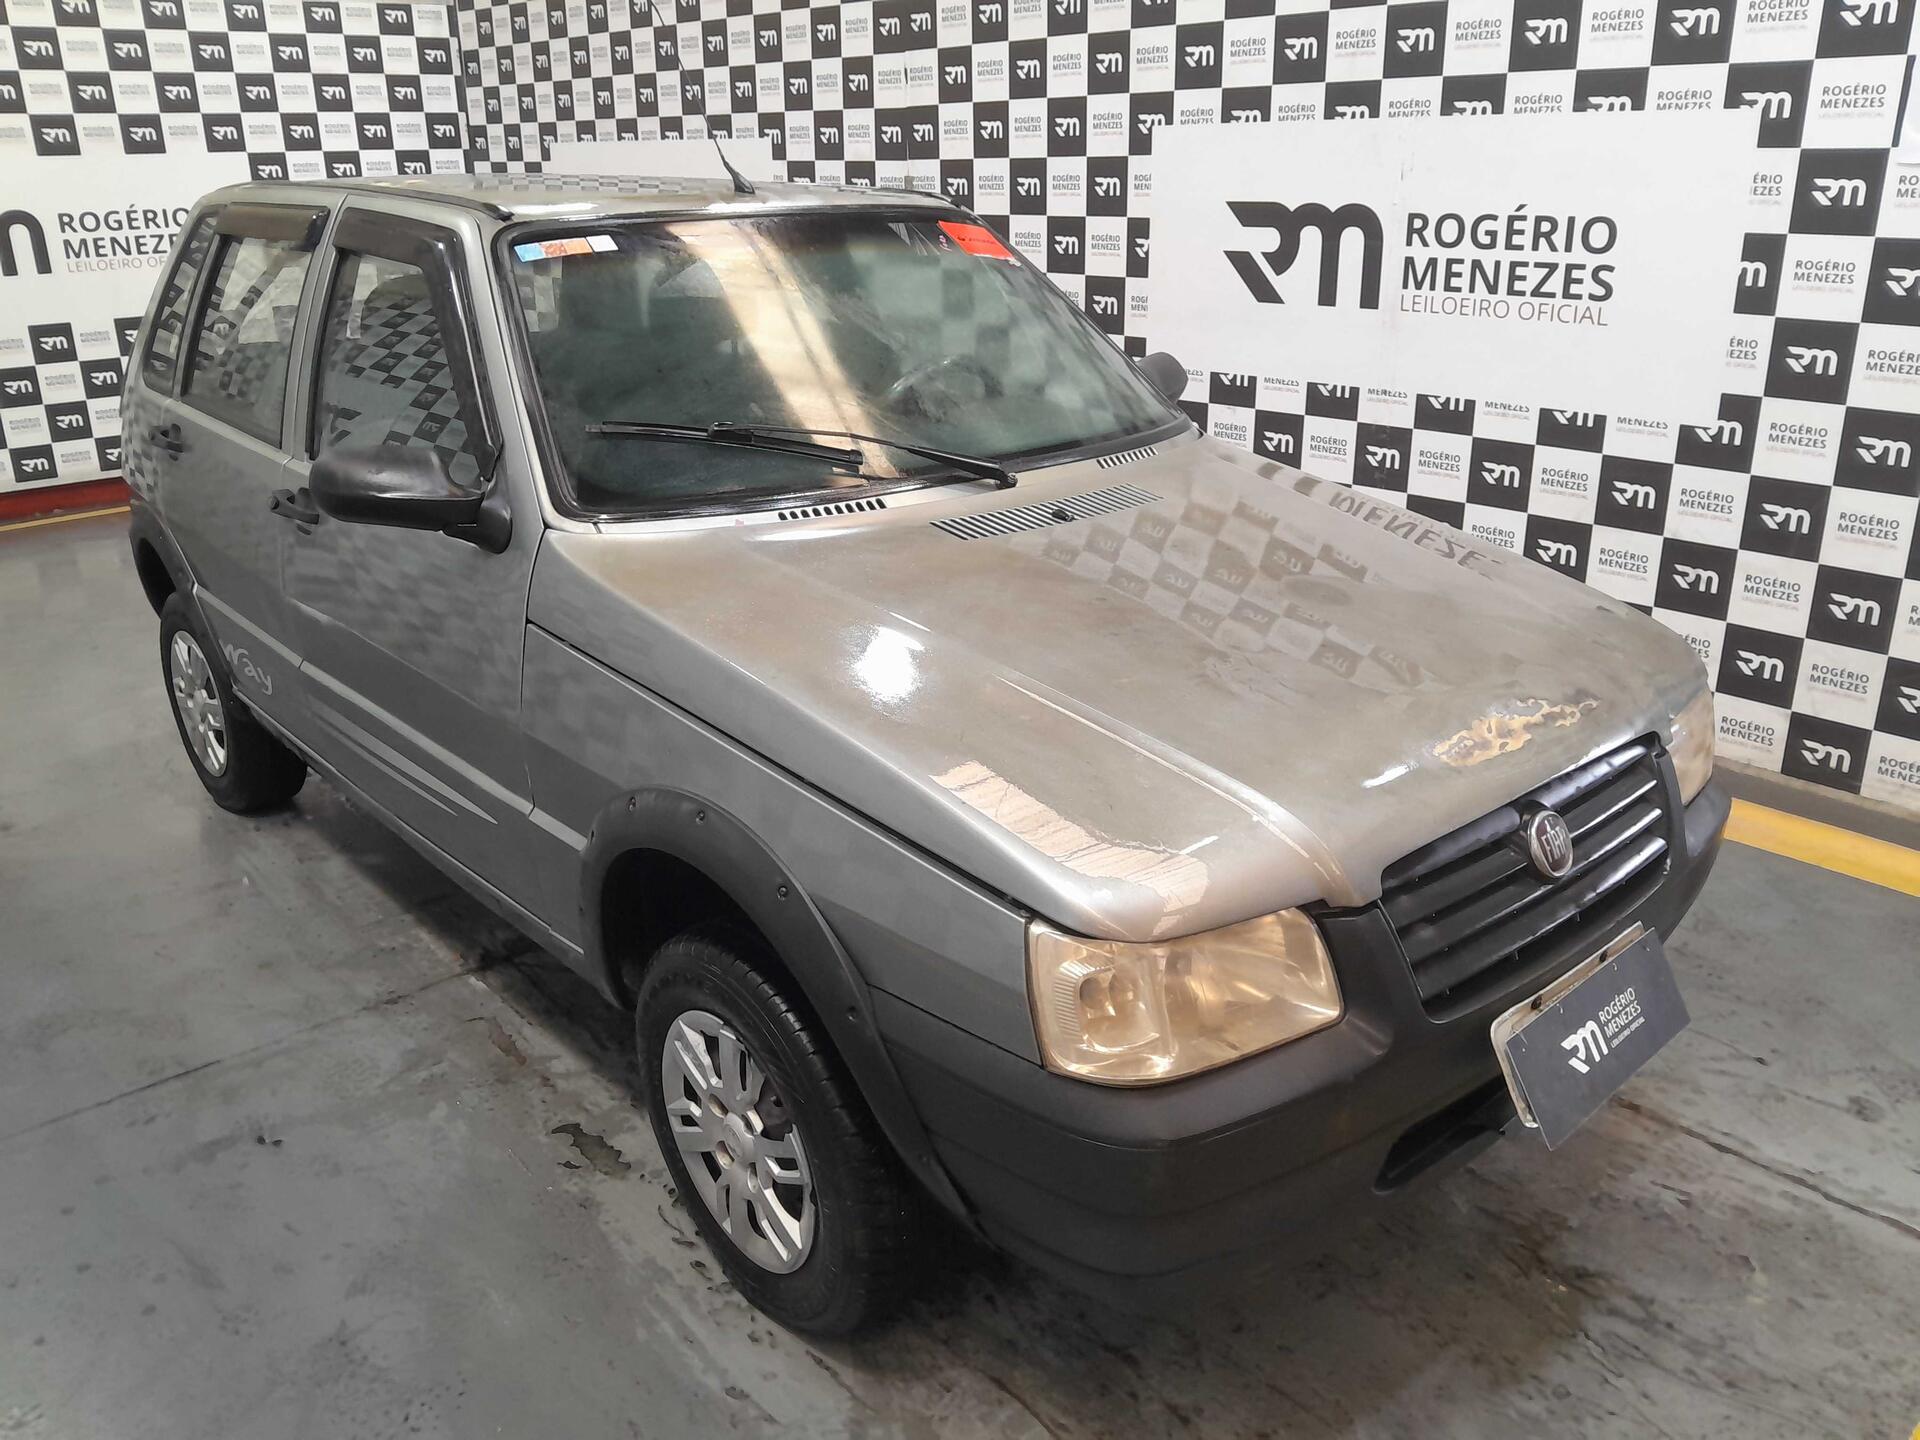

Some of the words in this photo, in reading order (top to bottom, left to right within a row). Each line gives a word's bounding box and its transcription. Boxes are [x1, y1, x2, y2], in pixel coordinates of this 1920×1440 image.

[1749, 0, 1809, 10] ROGÉRIO
[1592, 9, 1644, 21] ROGÉRIO
[1748, 10, 1807, 22] MENEZES
[1456, 19, 1501, 30] ROGÉRIO
[1591, 21, 1643, 32] MENEZES
[1336, 29, 1376, 39] ROGÉRIO
[1456, 30, 1500, 41] MENEZES
[1231, 38, 1266, 48] ROGÉRIO
[1336, 39, 1376, 49] MENEZES
[1137, 46, 1168, 55] ROGÉRIO
[1230, 48, 1266, 57] MENEZES
[1136, 55, 1168, 64] MENEZES
[1658, 90, 1712, 100] ROGÉRIO
[1823, 84, 1886, 96] ROGÉRIO
[1389, 100, 1431, 109] ROGÉRIO
[1515, 94, 1562, 104] ROGÉRIO
[1821, 97, 1884, 108] MENEZES
[1181, 108, 1213, 117] ROGÉRIO
[1279, 104, 1315, 113] ROGÉRIO
[58, 204, 190, 234] ROGÉRIO
[1405, 204, 1617, 258] ROGÉRIO
[67, 257, 142, 273] LEILOEIRO
[1796, 260, 1855, 272] ROGÉRIO
[1402, 256, 1616, 301] MENEZES
[1794, 272, 1854, 284] MENEZES
[1400, 294, 1510, 320] LEILOEIRO
[1517, 301, 1608, 326] OFICIAL
[1214, 422, 1246, 432] ROGÉRIO
[1770, 423, 1827, 437] ROGÉRIO
[1213, 431, 1246, 442] MENEZES
[1311, 435, 1347, 446] ROGÉRIO
[1769, 434, 1826, 448] MENEZES
[1310, 444, 1346, 456] MENEZES
[1420, 450, 1460, 462] ROGÉRIO
[1419, 460, 1460, 473] MENEZES
[1542, 468, 1588, 481] ROGÉRIO
[1541, 478, 1587, 493] MENEZES
[1681, 488, 1734, 503] ROGÉRIO
[1680, 499, 1732, 514] MENEZES
[1840, 512, 1899, 529] ROGÉRIO
[1472, 525, 1514, 539] ROGÉRIO
[1838, 524, 1897, 540] MENEZES
[1600, 548, 1648, 563] ROGÉRIO
[1599, 558, 1647, 573] MENEZES
[1746, 574, 1800, 592] ROGÉRIO
[1744, 585, 1799, 602] MENEZES
[1812, 664, 1869, 683] ROGÉRIO
[1810, 674, 1867, 694] MENEZES
[1722, 716, 1774, 736] ROGÉRIO
[1720, 726, 1773, 746] MENEZES
[1541, 826, 1566, 863] FIAT
[1598, 988, 1636, 1024] ROGÉRIO
[1604, 1000, 1641, 1038] MENEZES
